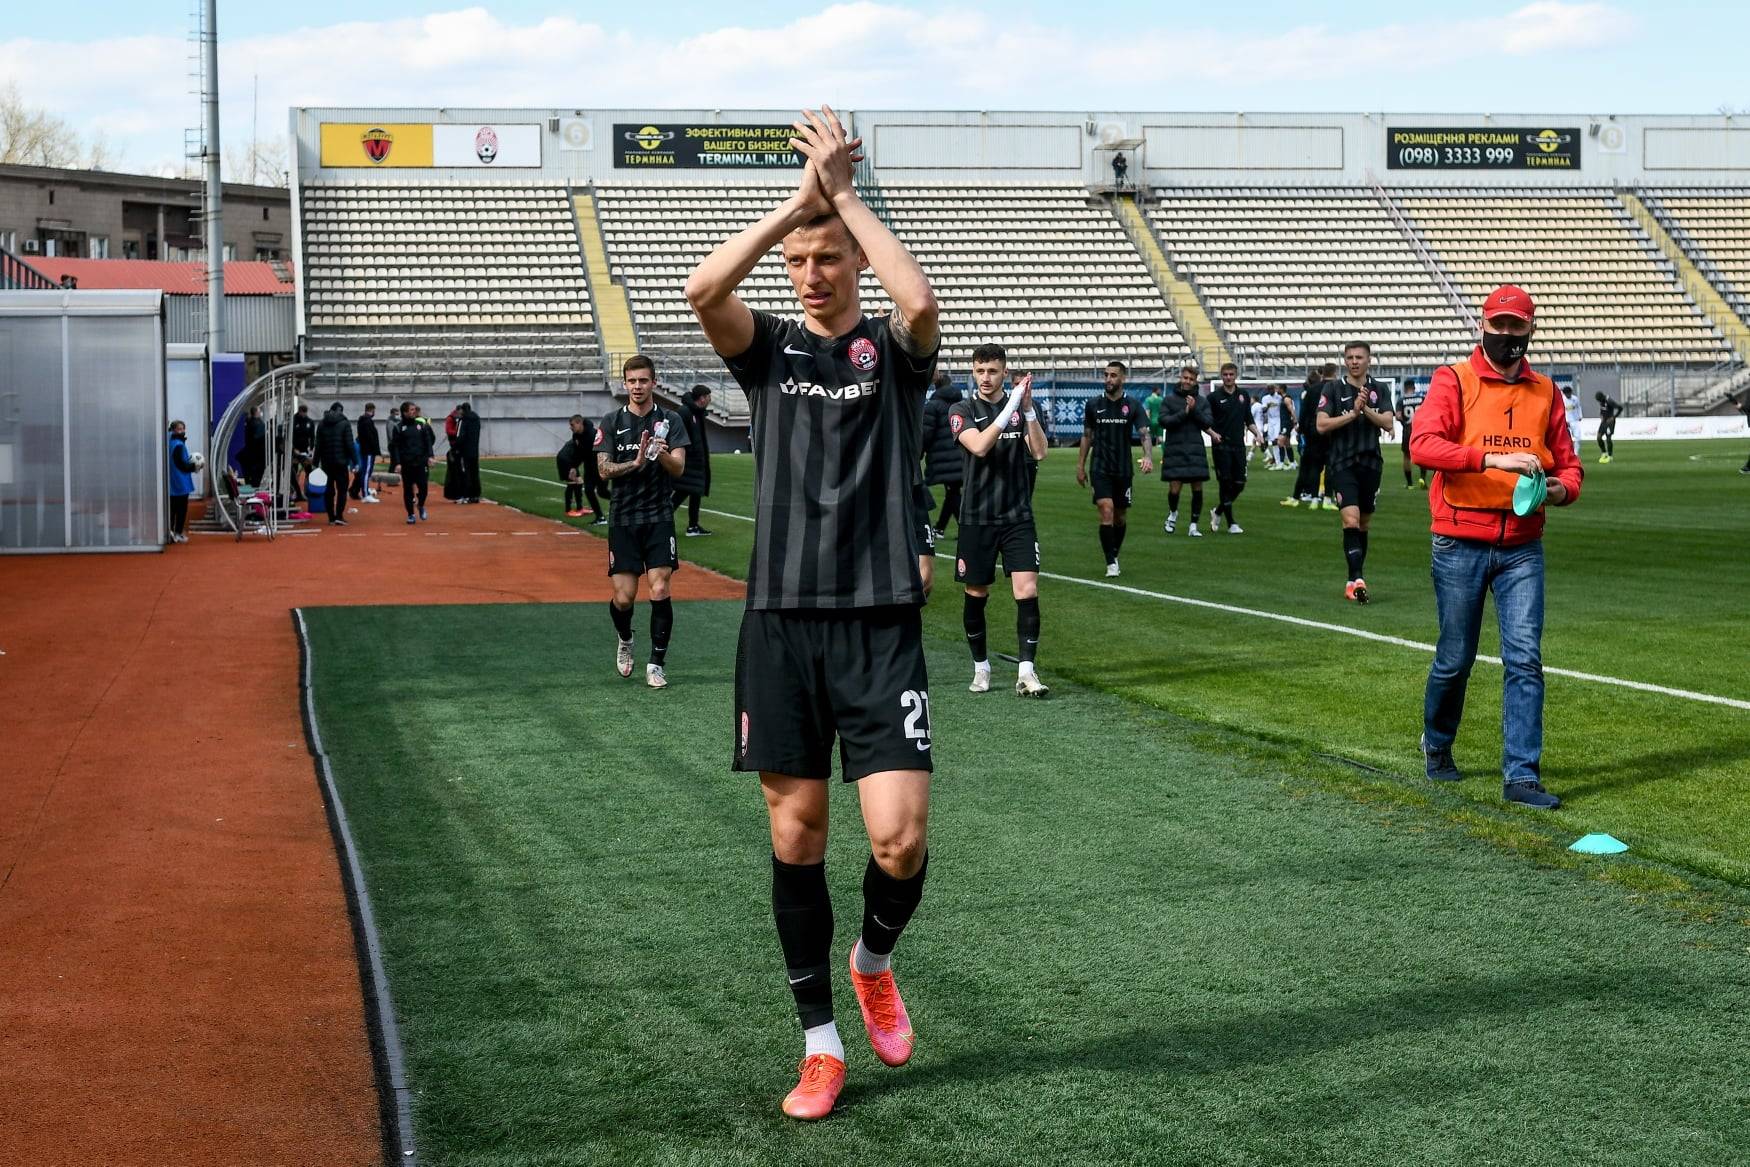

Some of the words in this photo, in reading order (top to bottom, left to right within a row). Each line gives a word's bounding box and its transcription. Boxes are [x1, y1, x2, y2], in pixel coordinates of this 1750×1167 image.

[685, 128, 761, 138] ЭФФЕКТИВНАЯ
[763, 129, 806, 138] РЕКЛАМ
[1395, 133, 1466, 146] РОЗМІЩЕННЯ
[1468, 134, 1519, 144] РЕКЛАМИ
[703, 141, 745, 150] ВАШЕГО
[747, 141, 793, 150] БИЗНЕСА
[697, 153, 800, 165] TERMINAL.IN.UA
[1399, 148, 1439, 166] (098)
[1444, 148, 1481, 164] 3333
[1486, 148, 1514, 164] 999
[1504, 406, 1513, 430] 1
[1483, 435, 1532, 448] HEARD
